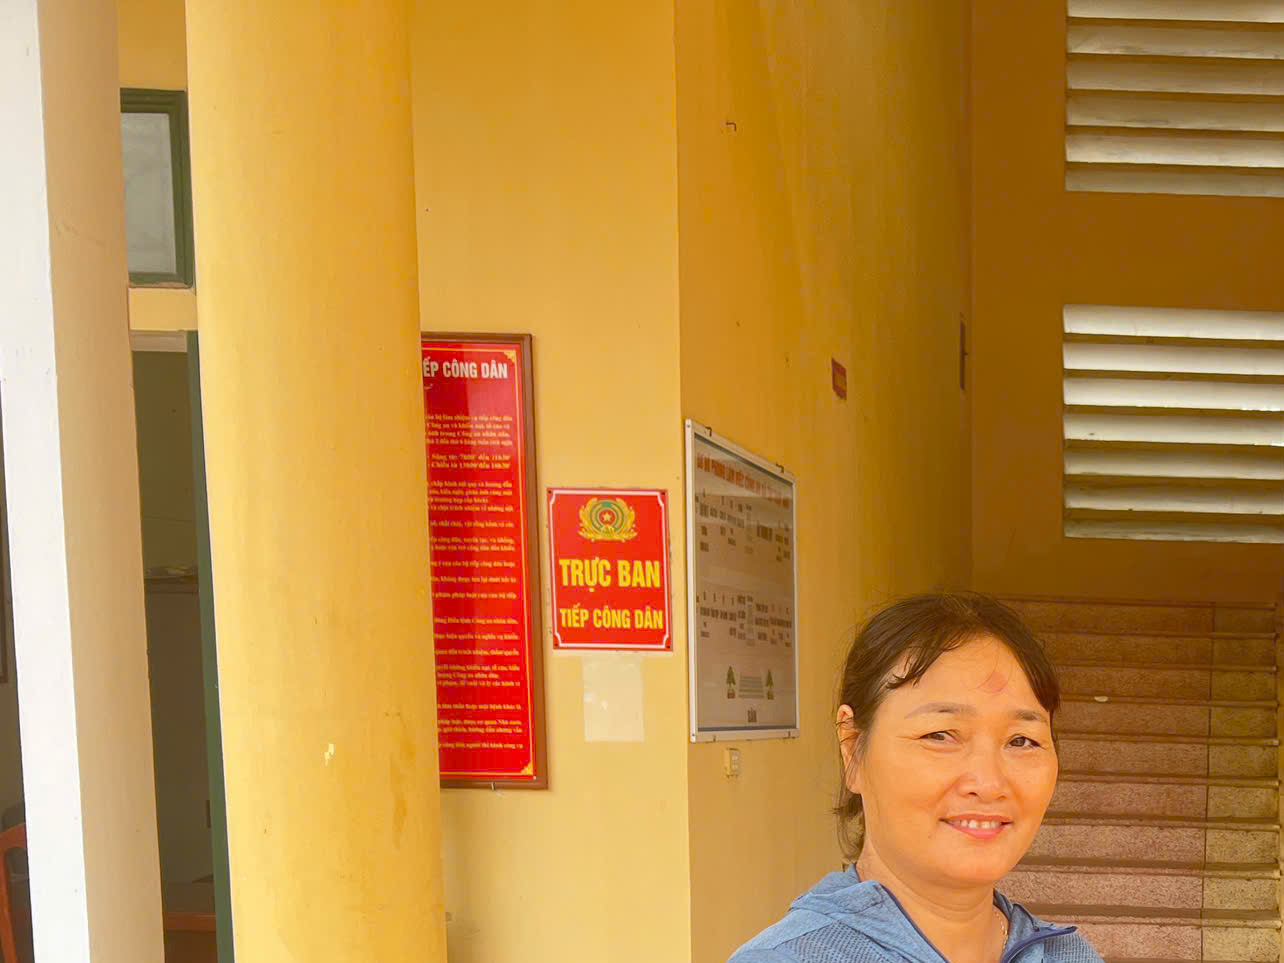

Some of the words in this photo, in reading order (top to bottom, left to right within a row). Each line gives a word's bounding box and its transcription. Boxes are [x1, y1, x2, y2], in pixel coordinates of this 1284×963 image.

[422, 356, 439, 378] ẾP
[443, 358, 478, 379] CÔNG
[481, 359, 508, 379] DÂN
[559, 556, 612, 593] TRỰC
[617, 560, 661, 588] BAN
[560, 602, 589, 629] TIẾP
[593, 605, 631, 629] CÔNG
[635, 606, 664, 630] DÂN
